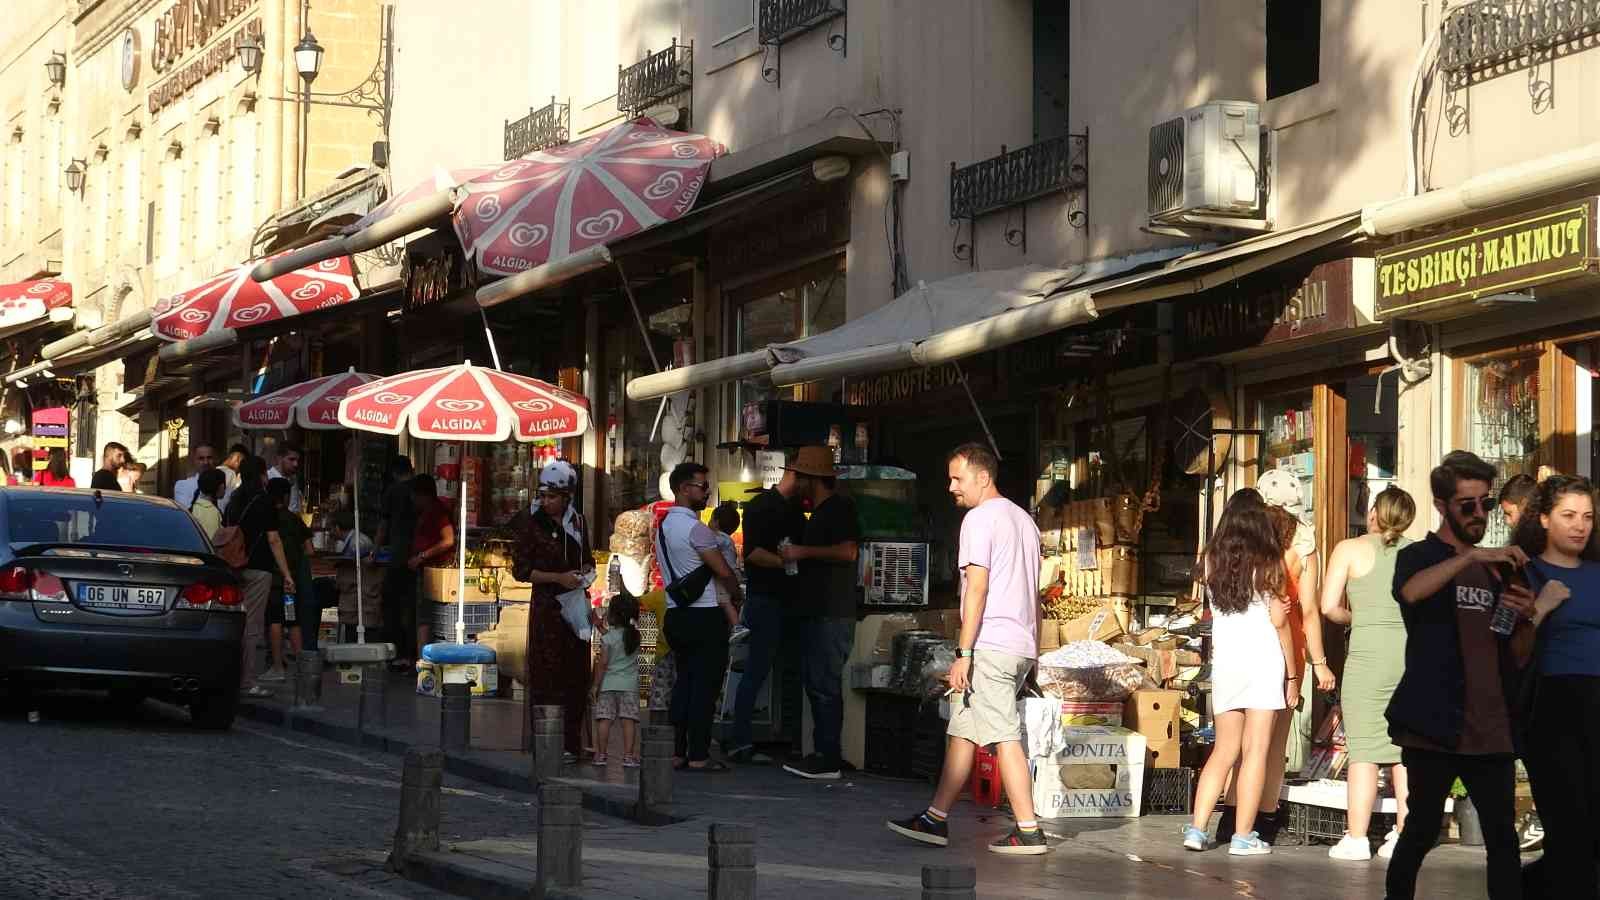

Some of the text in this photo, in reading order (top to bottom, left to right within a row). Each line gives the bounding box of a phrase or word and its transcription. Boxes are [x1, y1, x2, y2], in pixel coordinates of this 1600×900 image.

[1482, 218, 1584, 275] MAHMUT
[88, 587, 162, 604] 06 UN 587
[1062, 743, 1128, 759] BONITA
[1051, 791, 1134, 809] BANANAS
